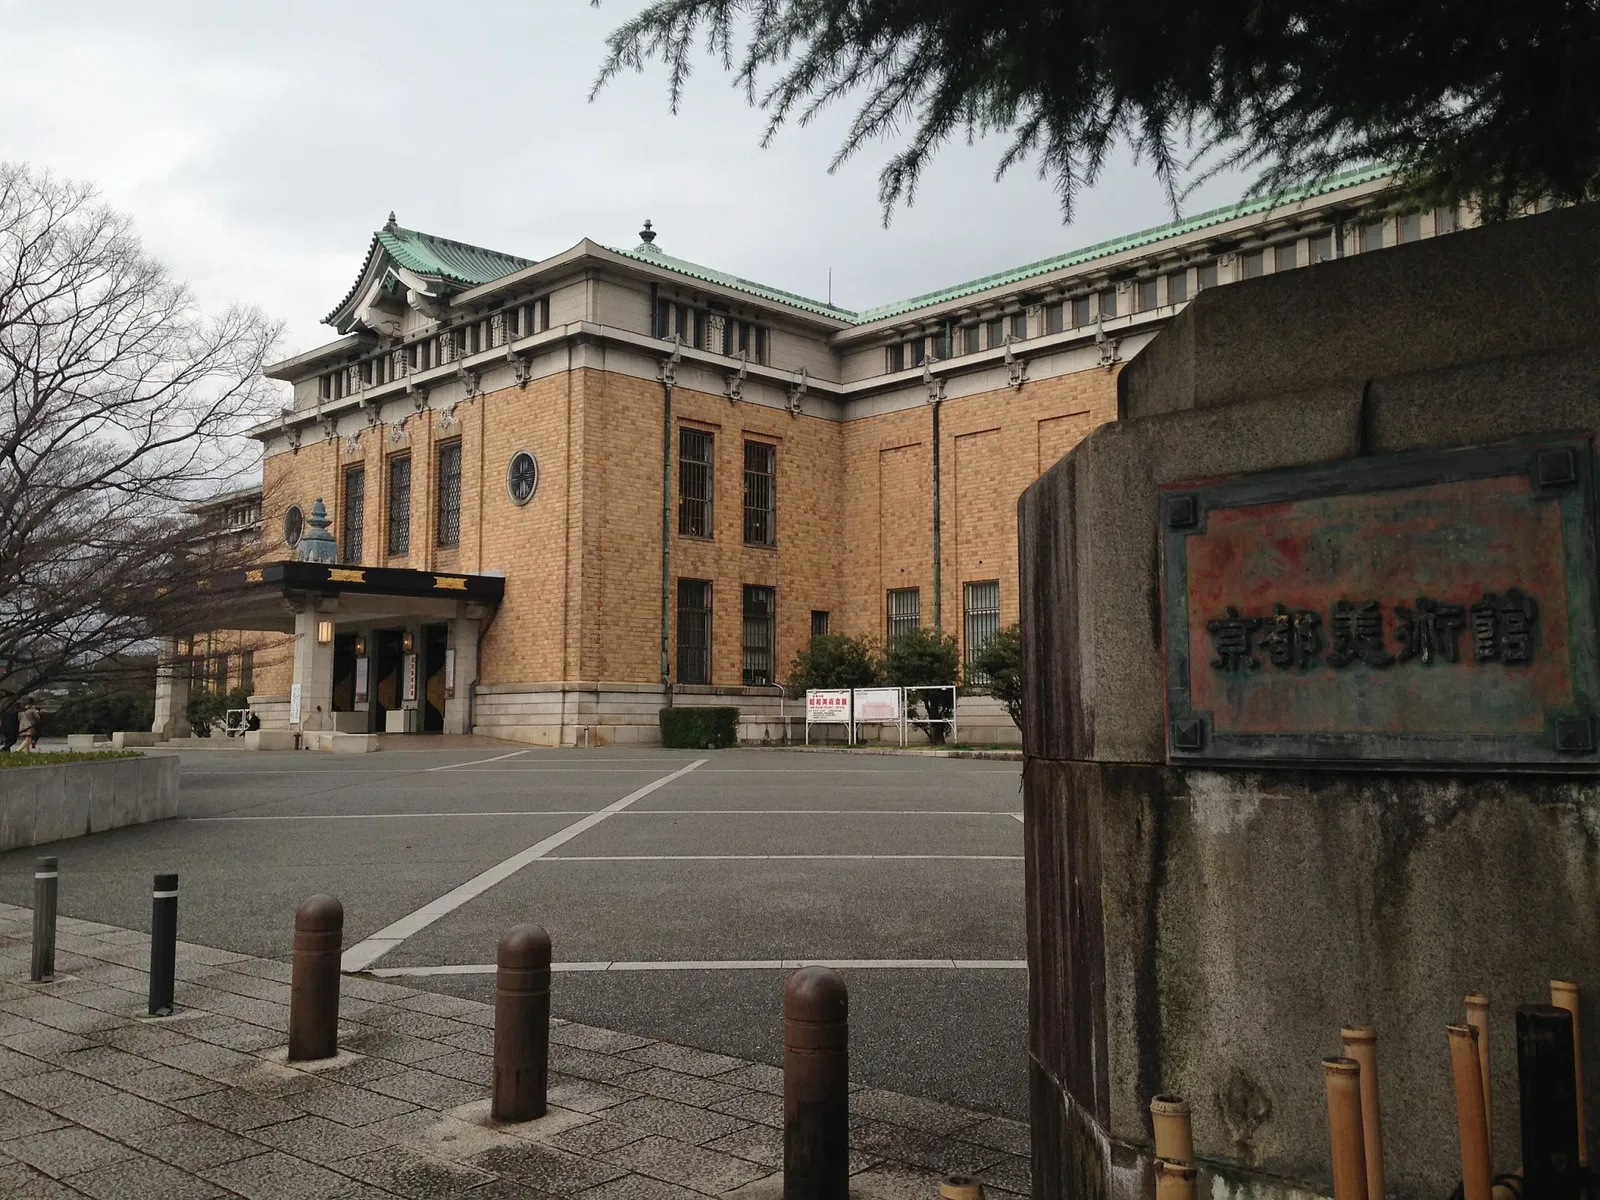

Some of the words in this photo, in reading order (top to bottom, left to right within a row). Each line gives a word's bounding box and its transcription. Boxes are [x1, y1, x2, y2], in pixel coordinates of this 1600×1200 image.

[1206, 589, 1537, 669] 京都美術館
